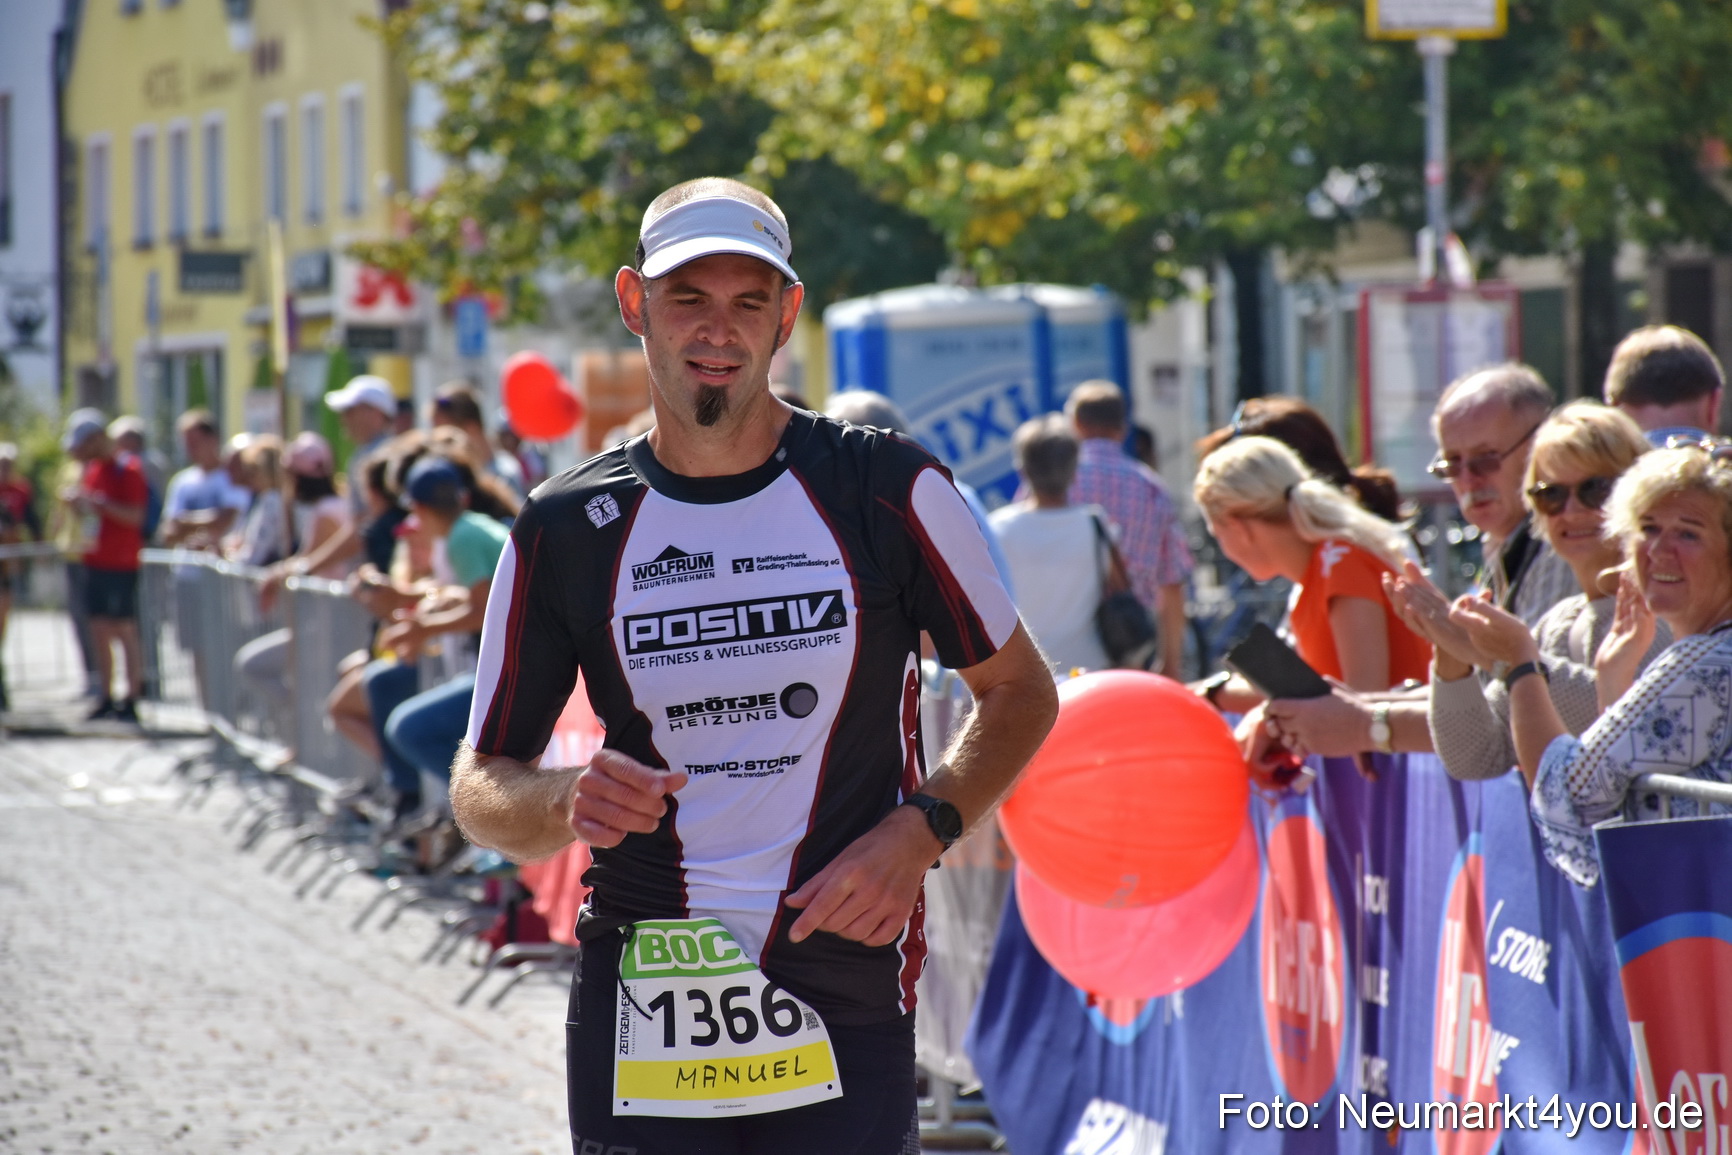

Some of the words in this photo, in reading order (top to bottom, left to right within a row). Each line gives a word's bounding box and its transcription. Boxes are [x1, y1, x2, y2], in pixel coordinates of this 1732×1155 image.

[915, 383, 1032, 463] IXI
[632, 555, 714, 581] WOLFRUM
[756, 552, 807, 563] Raiffeisenbank
[757, 560, 829, 571] Greding-Thalmässing
[632, 571, 715, 592] BAUUNTERNEHMEN
[629, 654, 646, 670] DIE
[649, 649, 699, 668] FITNESS
[704, 649, 714, 661] &
[717, 632, 841, 659] WELLNESSGRUPPE
[665, 692, 776, 719] BRÖTJE
[669, 709, 777, 732] HEIZUNG
[1489, 926, 1552, 985] STORE
[647, 981, 803, 1048] 1366
[675, 1055, 808, 1089] MANUEL
